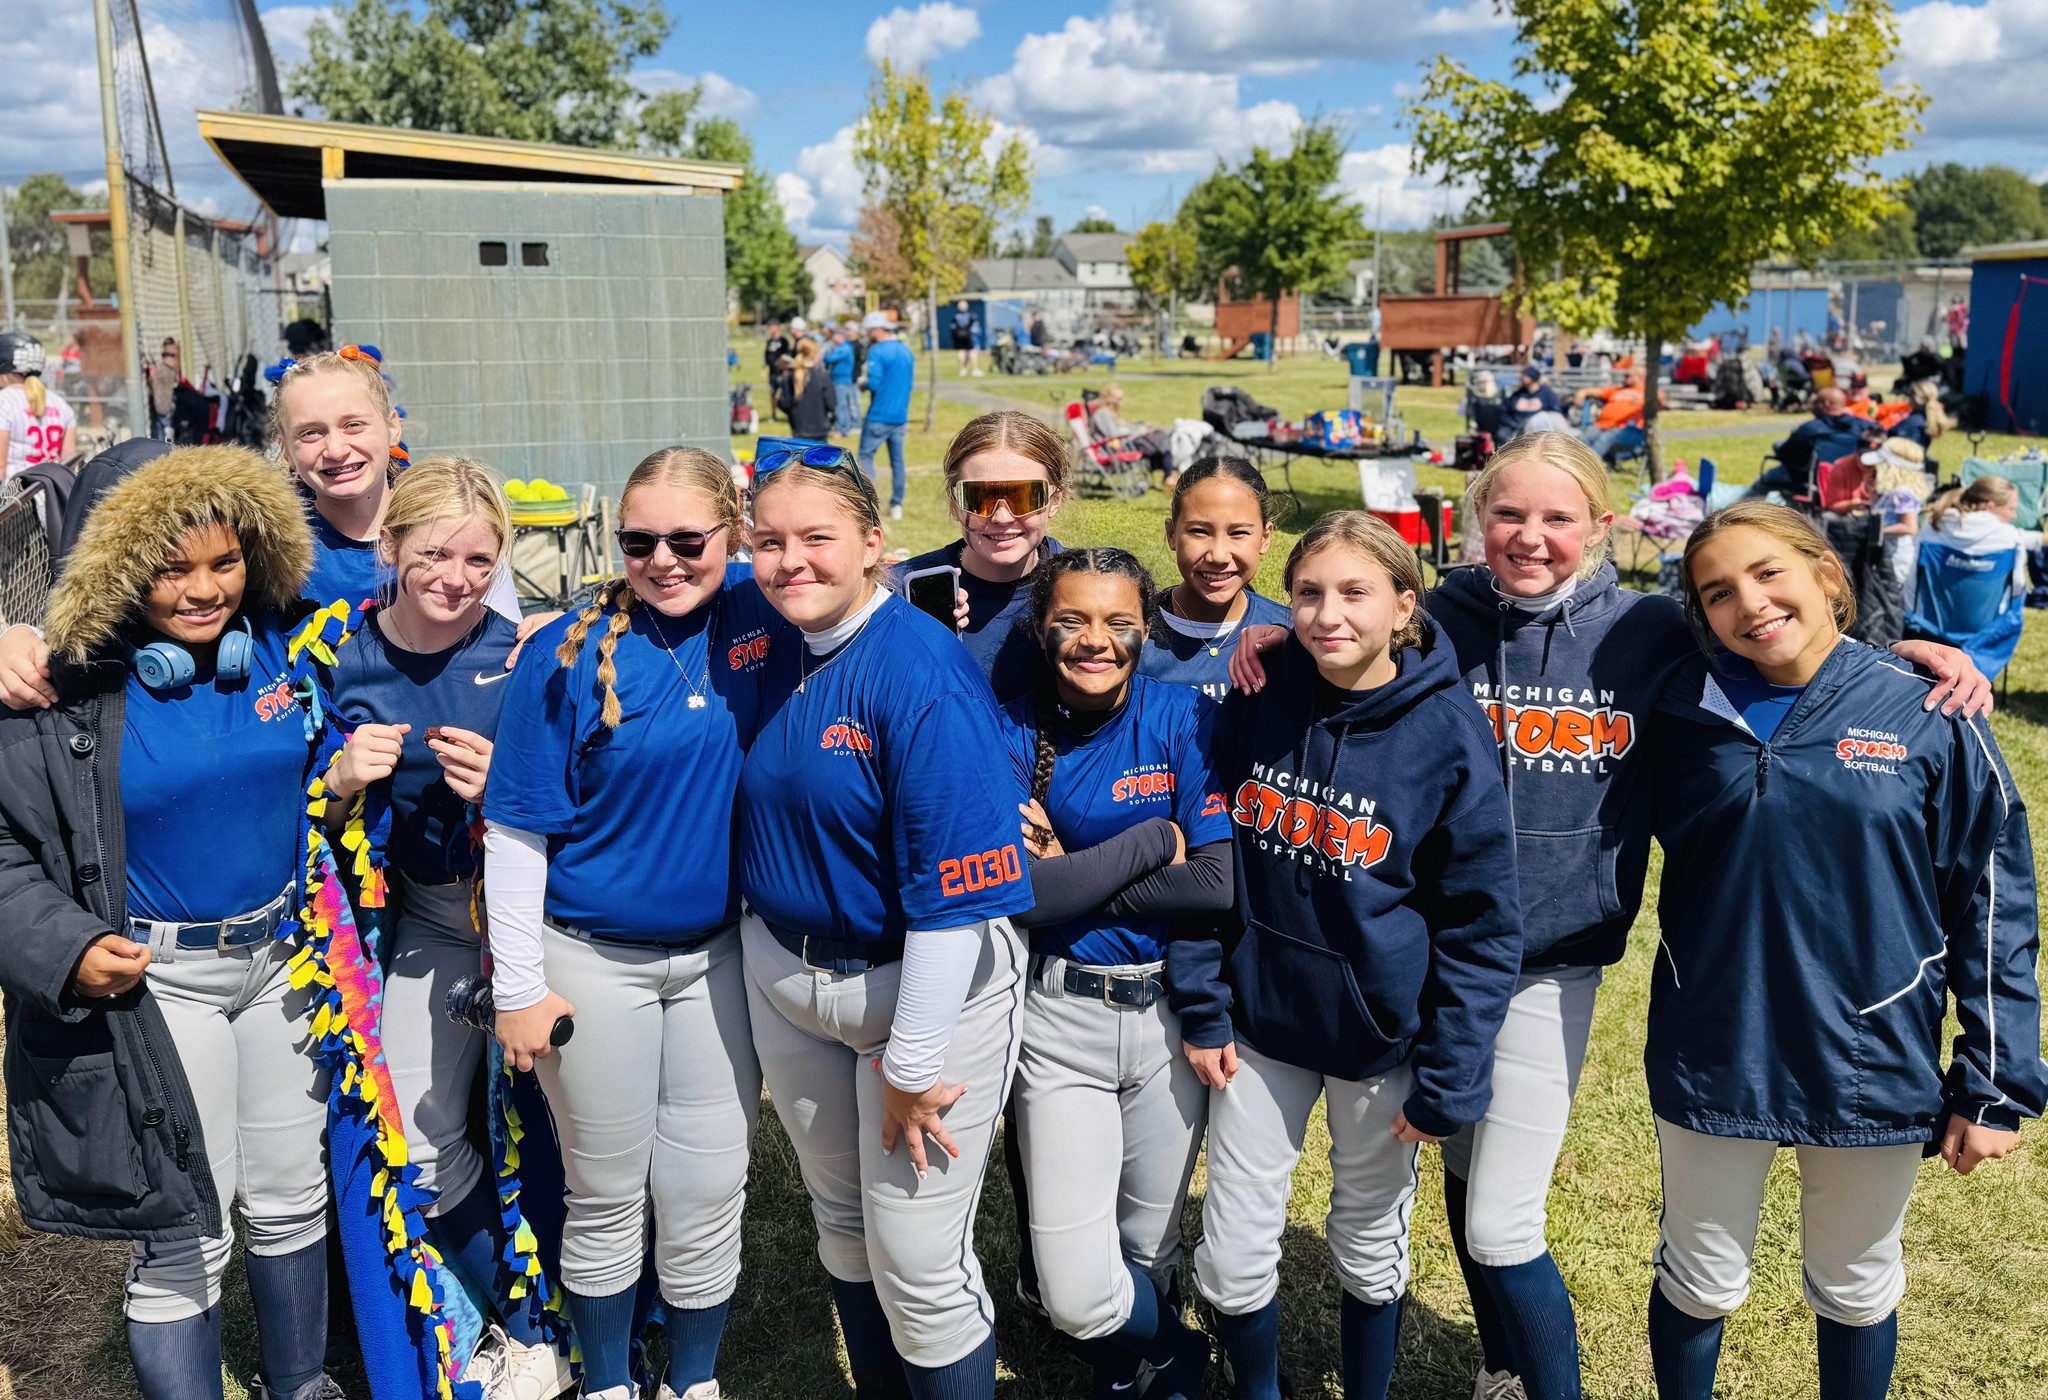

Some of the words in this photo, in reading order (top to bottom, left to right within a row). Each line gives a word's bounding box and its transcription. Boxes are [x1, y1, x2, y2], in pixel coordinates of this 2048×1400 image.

[1473, 682, 1615, 704] MICHIGAN
[1476, 699, 1636, 761] TORM
[1848, 727, 1898, 742] MICHIGAN
[1836, 739, 1906, 760] STORM
[1123, 763, 1169, 777] MICHIGAN
[1844, 760, 1898, 774] SOFTBALL
[1252, 762, 1377, 816] MICHIGAN
[1129, 794, 1171, 806] SOFTBALL
[1232, 779, 1393, 870] STORM
[938, 843, 1023, 897] 2030
